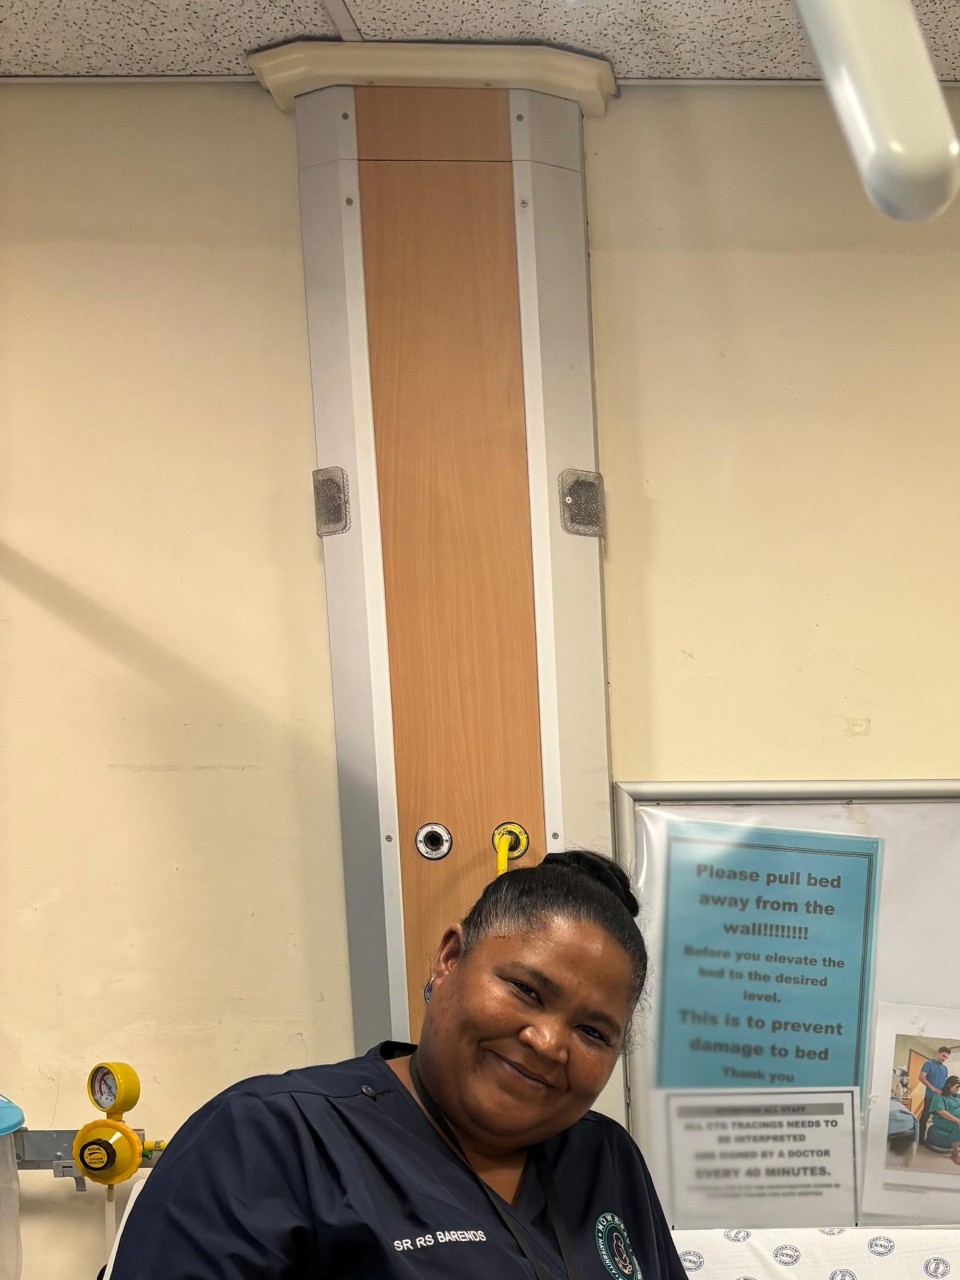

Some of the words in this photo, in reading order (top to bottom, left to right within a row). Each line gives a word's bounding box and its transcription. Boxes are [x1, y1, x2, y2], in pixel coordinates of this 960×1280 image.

[696, 863, 760, 882] Please
[766, 871, 800, 887] pull
[806, 872, 842, 889] bed
[698, 893, 750, 911] away
[755, 895, 798, 913] from
[804, 900, 835, 915] the
[683, 945, 731, 959] Before
[735, 951, 760, 964] you
[765, 952, 817, 966] elevate
[822, 956, 845, 969] the
[698, 966, 724, 979] bed
[729, 969, 743, 980] to
[747, 971, 771, 982] the
[775, 973, 828, 987] desired
[743, 989, 781, 1003] level.
[679, 1008, 719, 1026] This
[724, 1012, 740, 1027] is
[746, 1015, 765, 1029] to
[771, 1018, 843, 1036] prevent
[689, 1037, 764, 1058] damage
[770, 1043, 789, 1058] to
[794, 1045, 829, 1061] bed
[722, 1066, 764, 1080] Thank
[769, 1070, 795, 1083] you
[731, 1121, 784, 1130] TRACINGS
[787, 1120, 821, 1129] NEEDS
[824, 1119, 838, 1128] TO
[734, 1134, 806, 1144] INTERPRETED
[719, 1150, 758, 1160] SIGNED
[760, 1150, 775, 1158] BY
[777, 1150, 786, 1158] A
[787, 1149, 831, 1158] DOCTOR
[694, 1168, 741, 1180] EVERY
[745, 1167, 761, 1178] 40
[765, 1166, 832, 1177] MINUTES.
[394, 1239, 414, 1251] SR
[416, 1235, 435, 1247] RS
[436, 1230, 487, 1243] BARENDS
